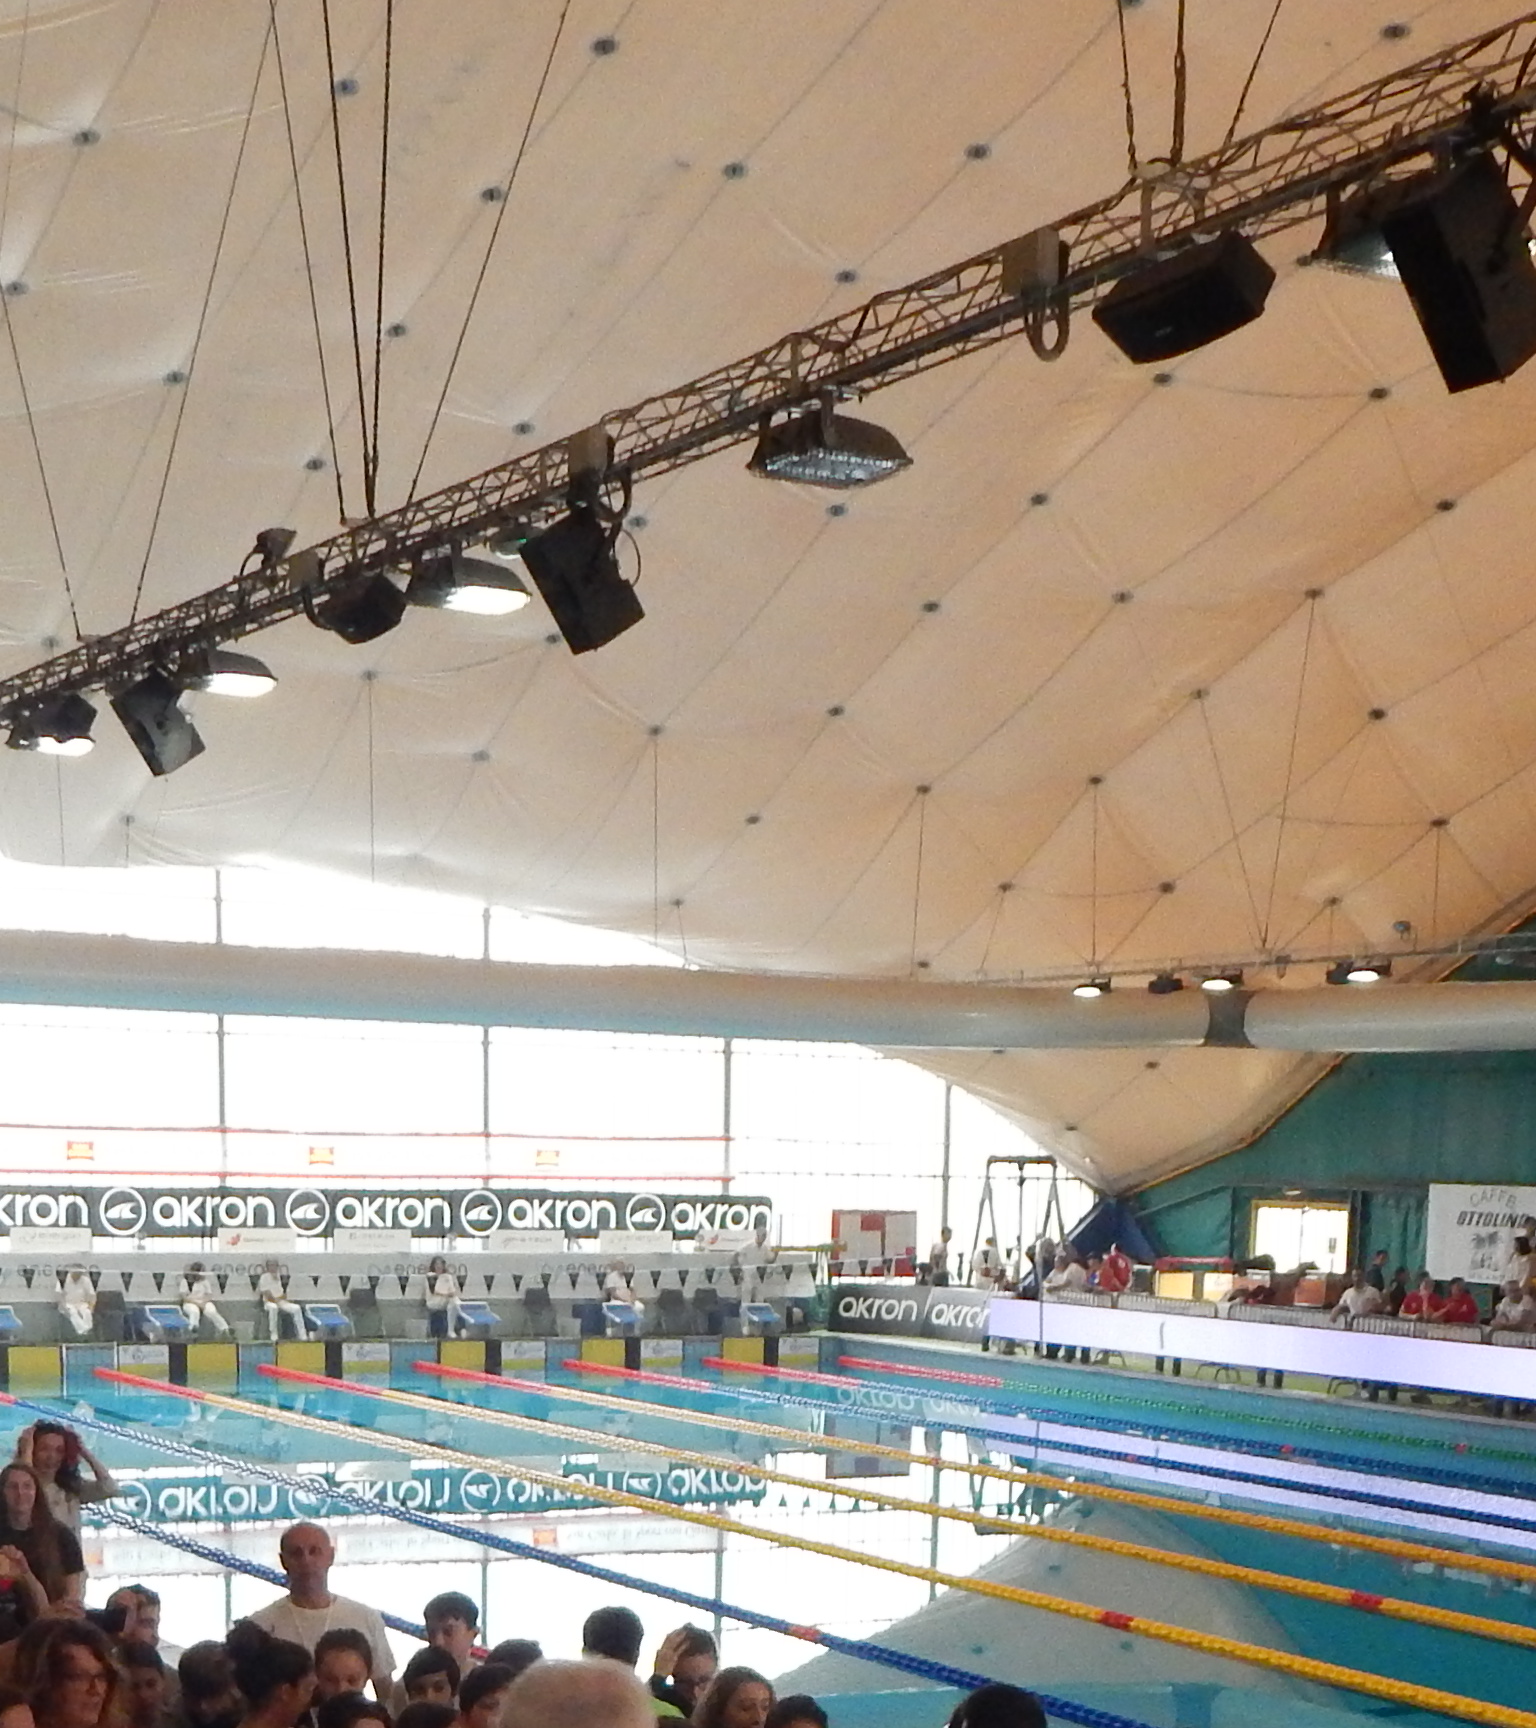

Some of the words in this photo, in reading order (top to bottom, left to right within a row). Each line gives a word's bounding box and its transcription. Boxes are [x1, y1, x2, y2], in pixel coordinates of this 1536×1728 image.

[152, 1195, 276, 1228] akron
[335, 1196, 451, 1229] akron
[507, 1198, 616, 1230] akron
[670, 1201, 772, 1231] akron
[838, 1296, 918, 1322] akron
